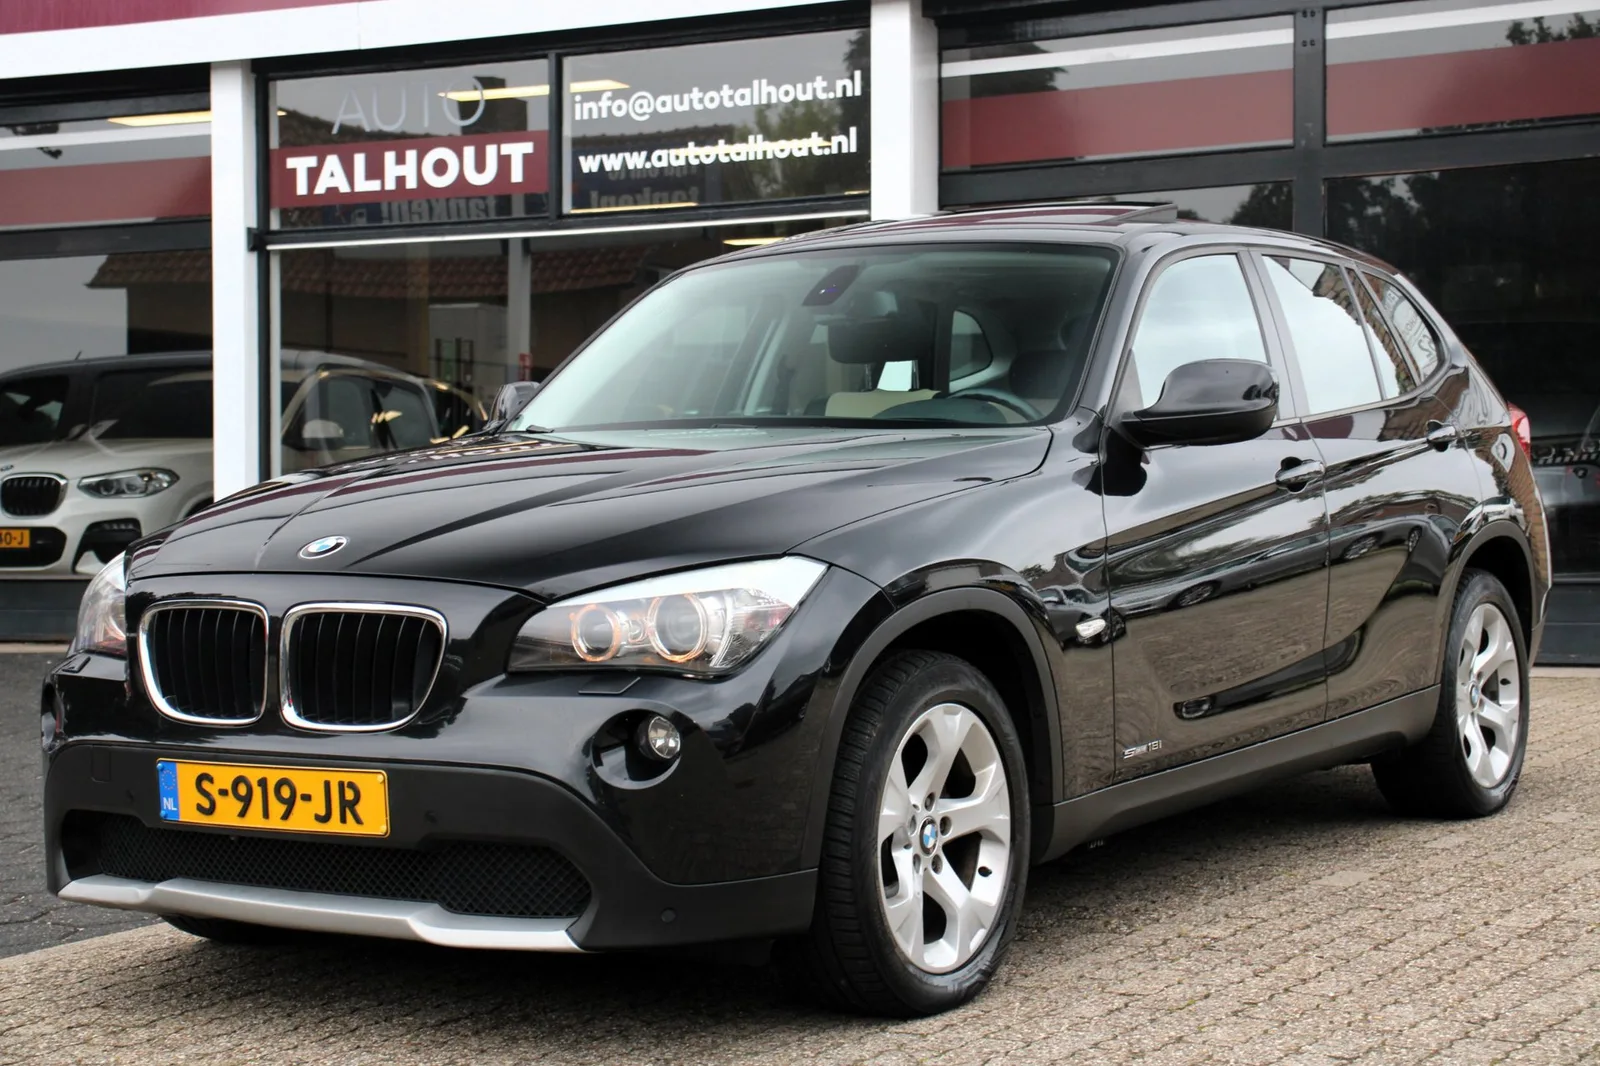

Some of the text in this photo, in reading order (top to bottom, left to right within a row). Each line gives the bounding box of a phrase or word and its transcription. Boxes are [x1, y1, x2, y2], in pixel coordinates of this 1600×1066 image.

[331, 76, 486, 135] AUTO
[574, 70, 862, 122] info@autotalhout.nl
[286, 141, 534, 195] TALHOUT
[579, 126, 858, 174] www.autotalhout.nl
[163, 797, 178, 811] NL
[195, 772, 364, 825] S-919-JR
